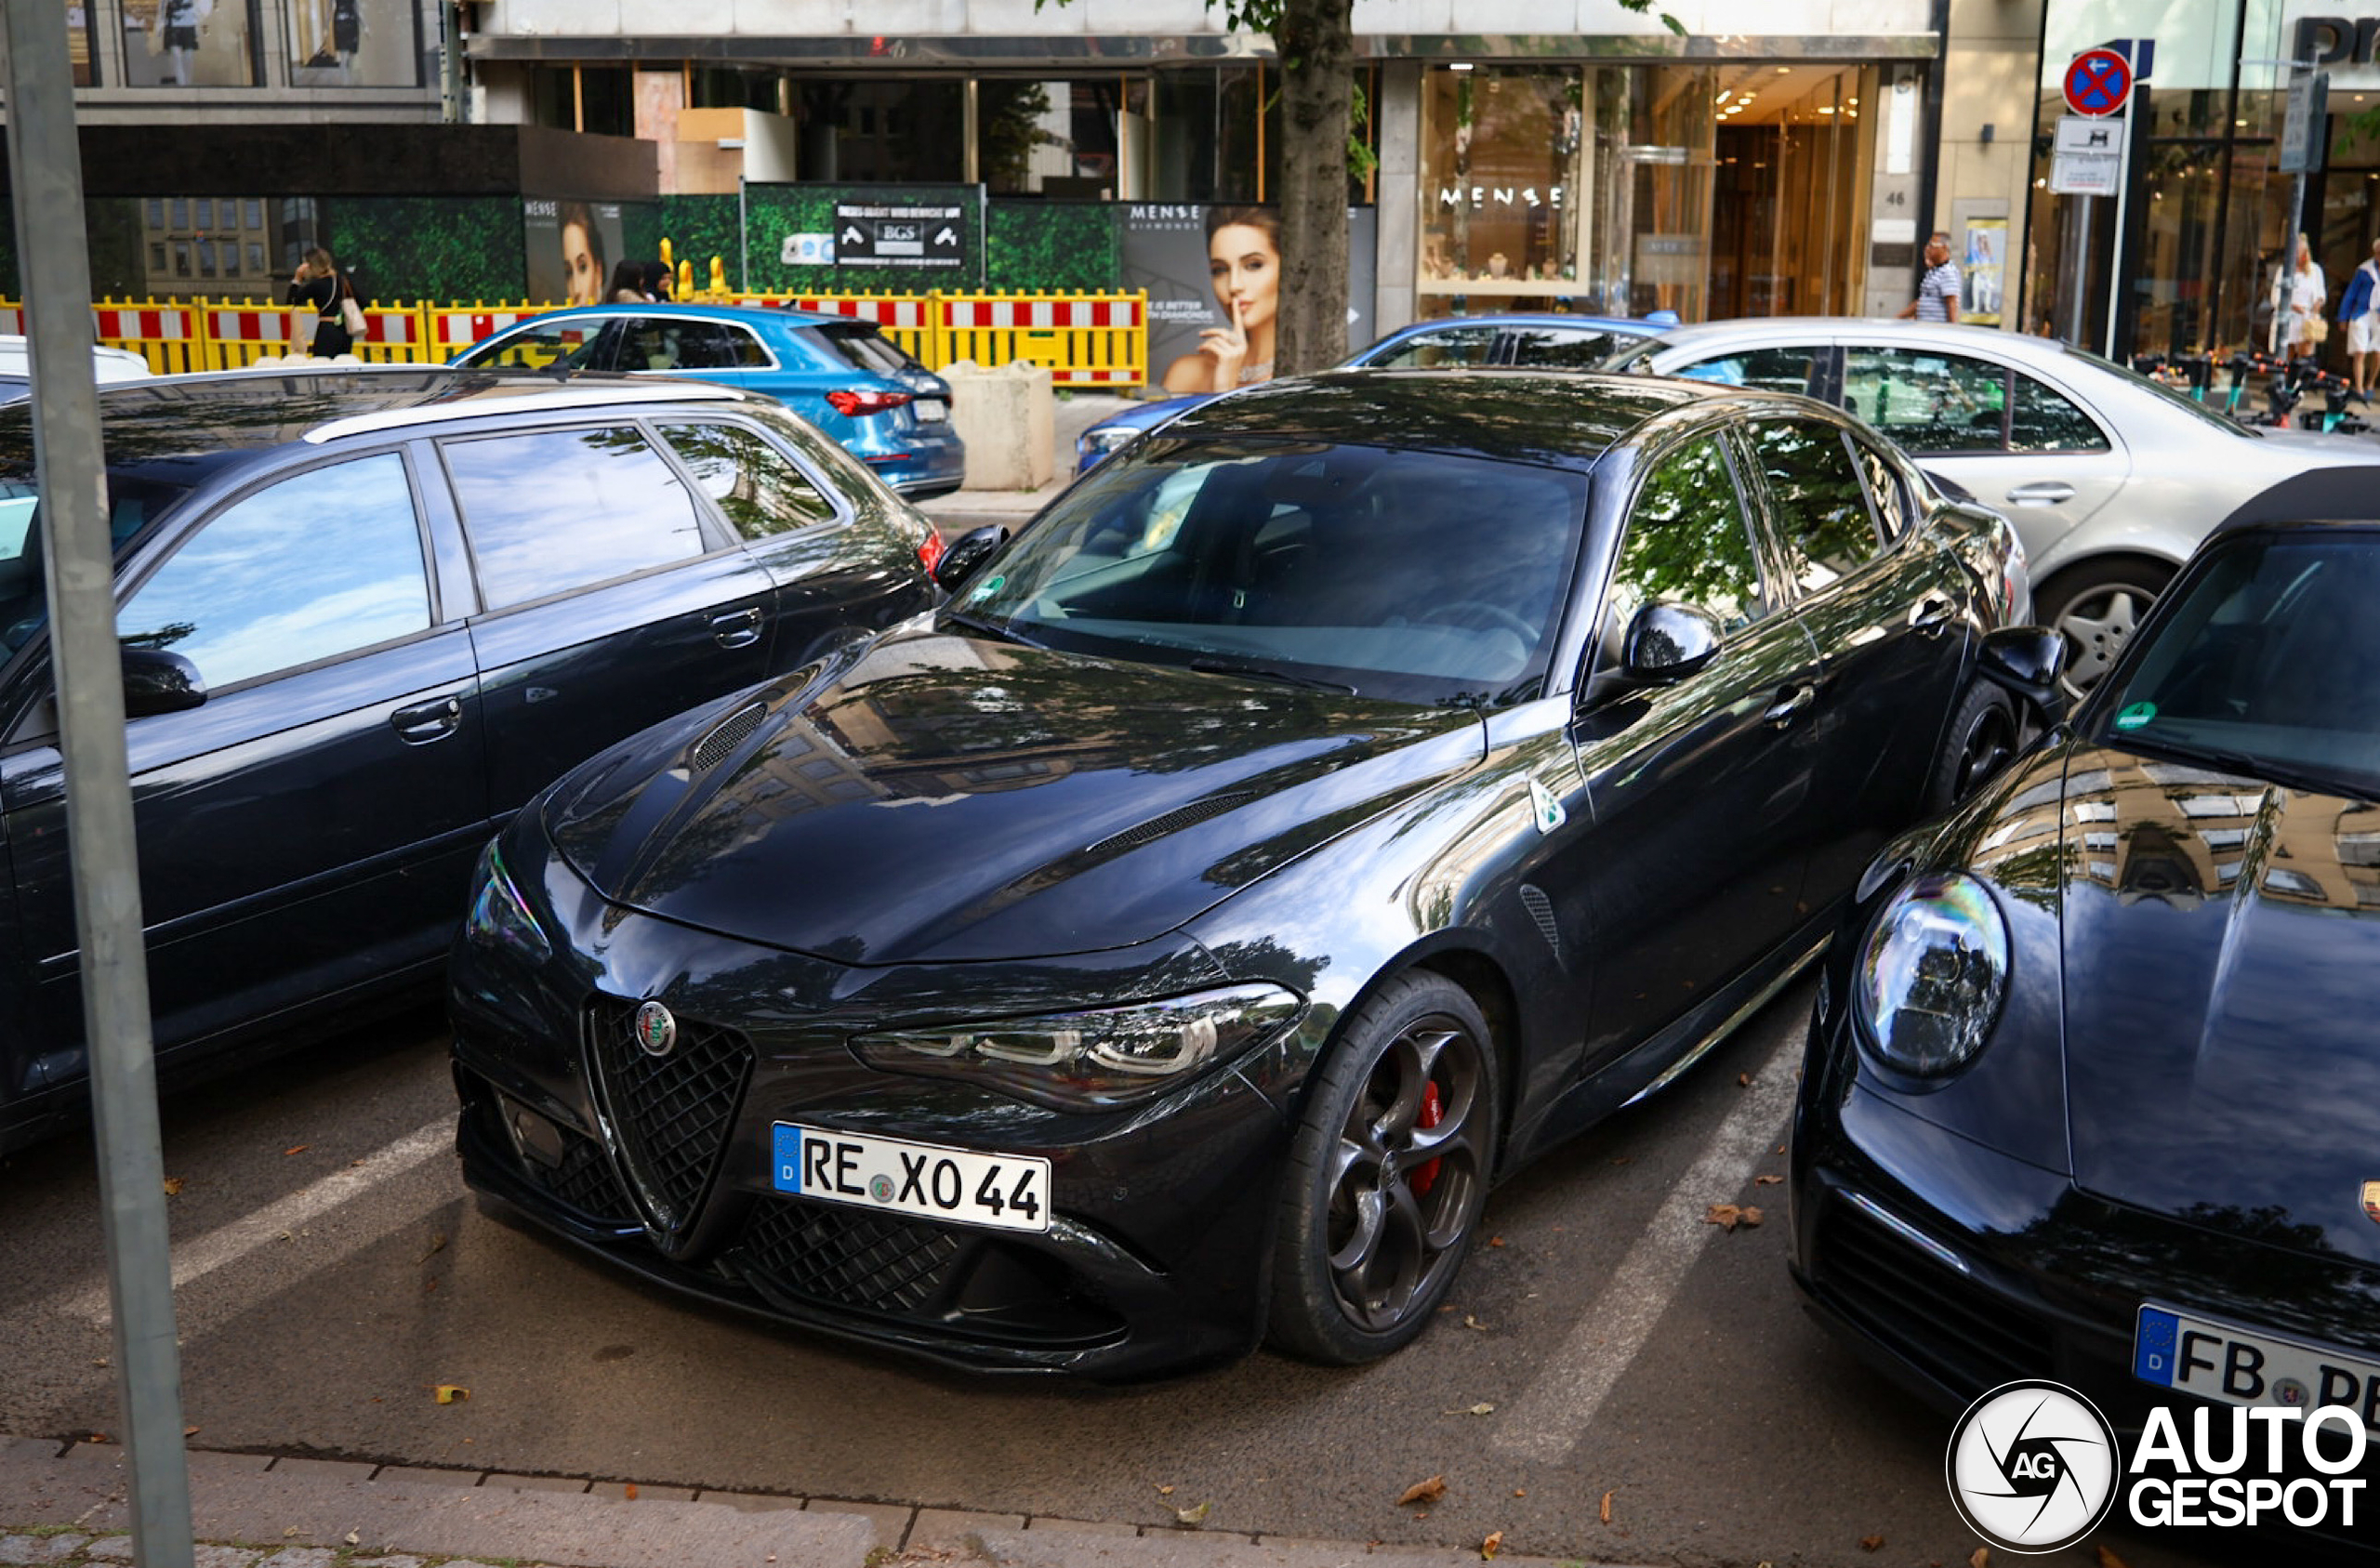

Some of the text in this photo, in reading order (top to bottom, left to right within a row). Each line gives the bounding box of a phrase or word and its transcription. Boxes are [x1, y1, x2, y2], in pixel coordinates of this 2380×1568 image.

[782, 1165, 794, 1180] D
[804, 1137, 1039, 1220] RE XO 44
[2149, 1352, 2163, 1371] D
[2177, 1330, 2266, 1400] FB
